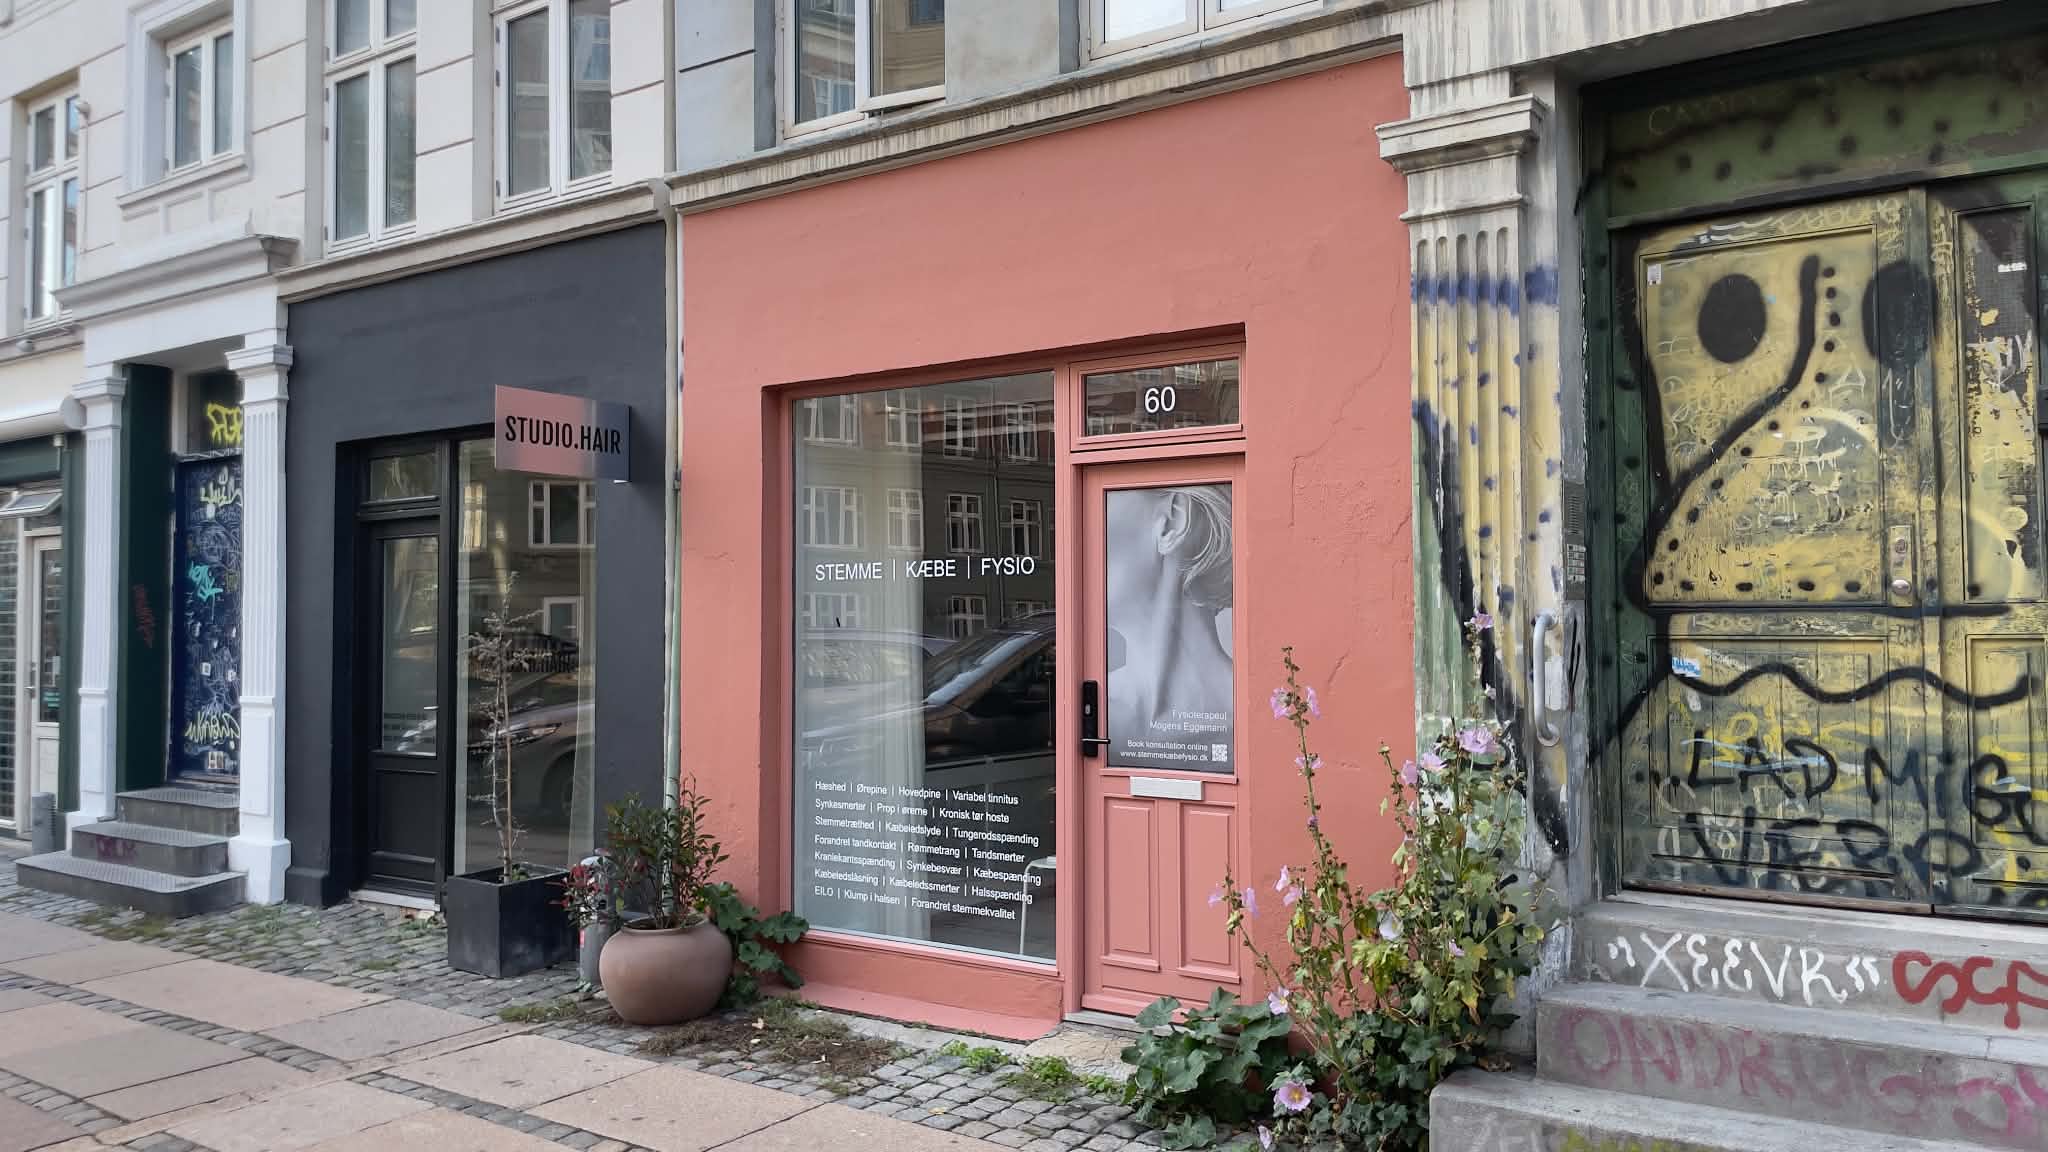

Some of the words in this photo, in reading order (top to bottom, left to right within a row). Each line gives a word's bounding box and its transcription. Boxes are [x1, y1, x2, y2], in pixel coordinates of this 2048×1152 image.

[1144, 385, 1176, 414] 60
[504, 415, 622, 455] STUDIO.HAIR
[815, 562, 883, 582] STEMME
[905, 559, 956, 578] KÆBE
[981, 556, 1035, 576] FYSIO
[1127, 739, 1144, 748] Book
[1187, 743, 1208, 752] online
[815, 780, 846, 792] Hæshed
[856, 783, 887, 796] Ørepine
[898, 785, 941, 800] Hovedpine
[952, 790, 986, 802] Variabel
[987, 793, 1019, 805] tinnitus
[815, 798, 866, 811] Synkesmerter
[876, 802, 896, 815] Prop
[939, 807, 970, 820] Kronisk
[972, 811, 984, 821] tør
[986, 811, 1010, 823] hoste
[815, 815, 875, 830] Stemmetræthed
[885, 821, 941, 837] Kæbeledslyde
[952, 827, 1039, 848] Tungerodsspænding
[814, 834, 850, 846] Forandret
[852, 838, 897, 850] tandkontakt
[907, 842, 960, 859] Rømmetrang
[971, 847, 1025, 863] Tandsmerter
[814, 868, 879, 887] Kæbeledslåsning
[889, 876, 960, 894] Kæbeledssmerter
[971, 885, 1033, 905] Halsspænding
[906, 860, 962, 875] Synkebesvær
[973, 867, 1041, 887] Kæbespænding
[814, 885, 834, 897] EILO
[844, 889, 868, 902] Klump
[874, 893, 900, 905] halsen
[911, 897, 951, 912] Forandret
[952, 903, 1016, 920] stemmekvalitet
